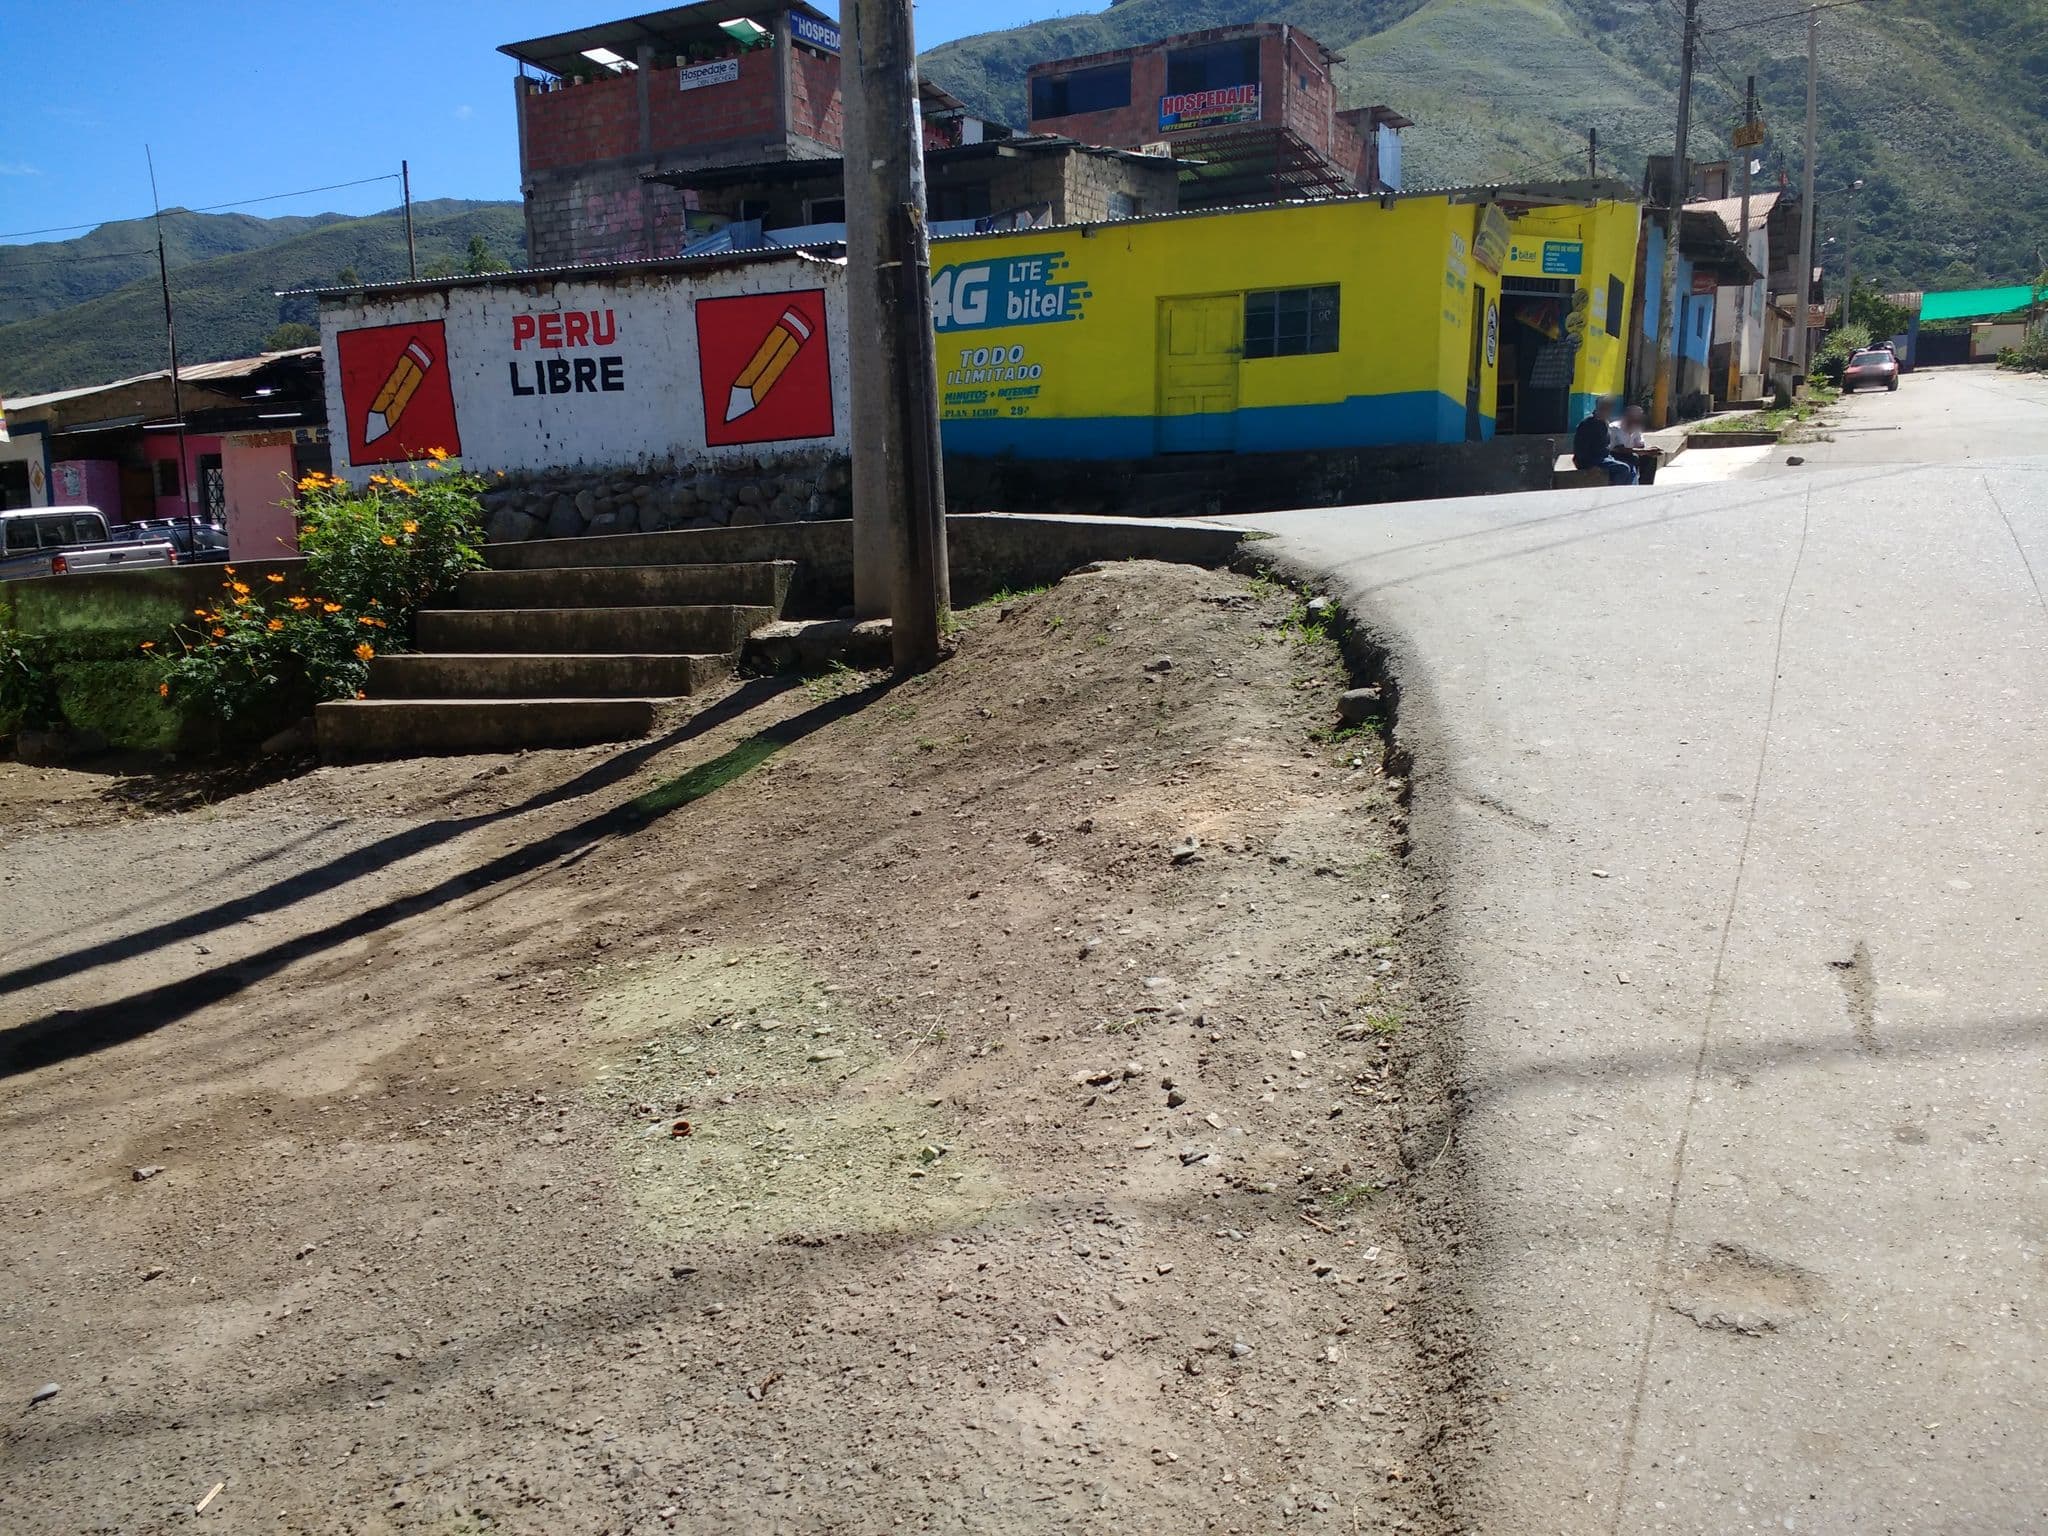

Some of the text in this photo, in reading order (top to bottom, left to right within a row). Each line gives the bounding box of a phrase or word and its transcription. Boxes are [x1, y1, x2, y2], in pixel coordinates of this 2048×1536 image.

[681, 63, 728, 81] Hospedaje
[1162, 84, 1256, 118] HOSPEDAJE
[1009, 261, 1042, 283] LTE
[932, 266, 990, 327] 4G
[1007, 285, 1064, 320] bitel
[512, 309, 616, 350] PERU
[960, 344, 1025, 369] TODO
[509, 356, 625, 396] LIBRE
[946, 364, 1042, 385] ILIMITADO
[945, 390, 988, 401] MINUTOS
[998, 385, 1041, 398] INTERNET
